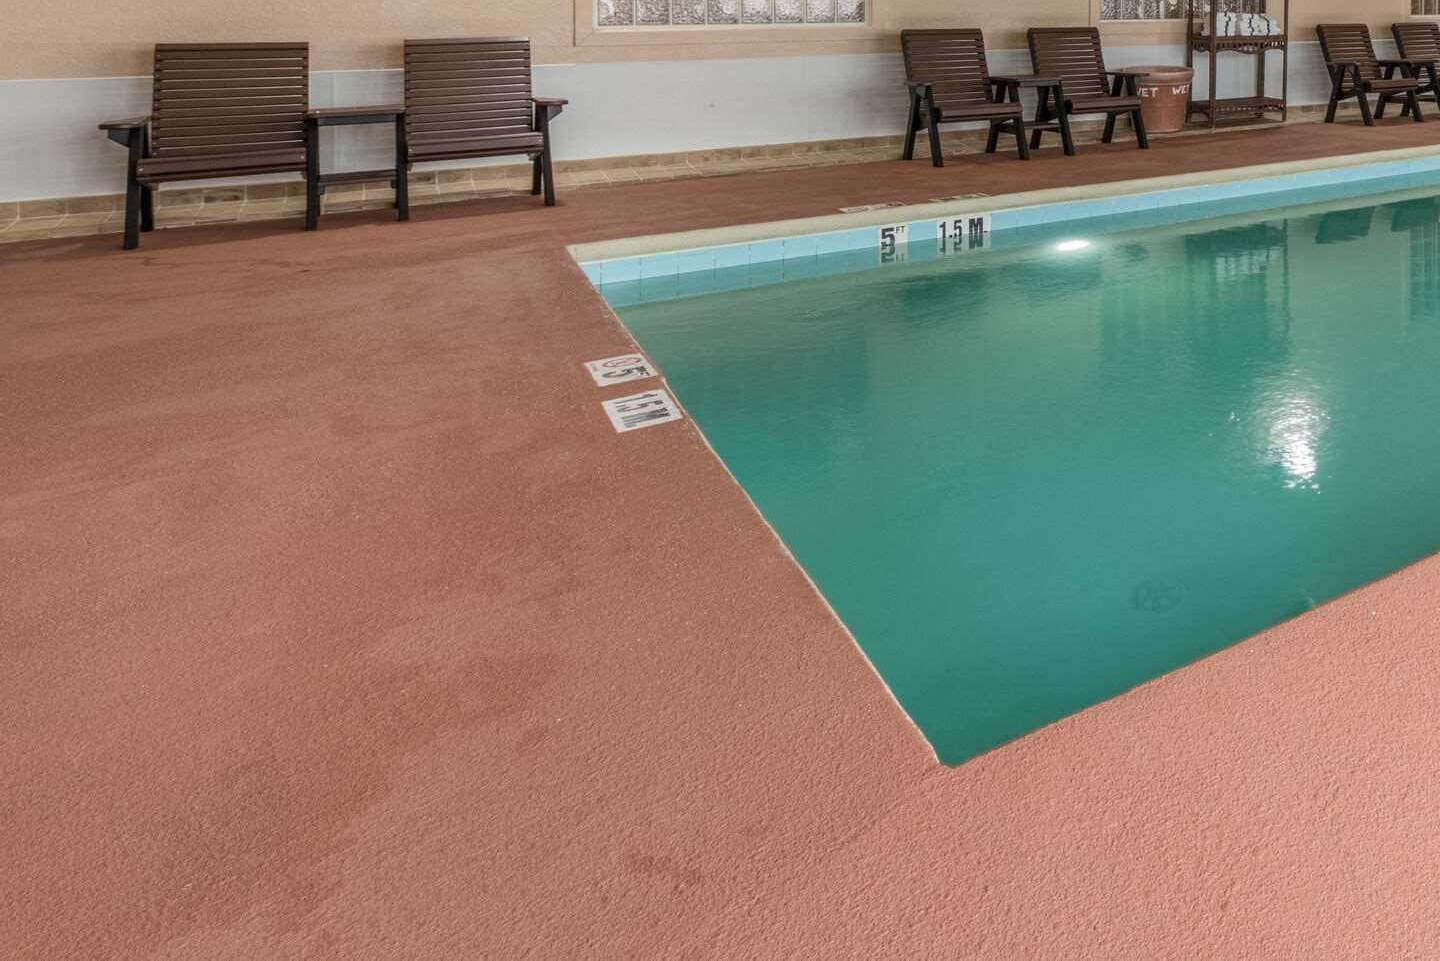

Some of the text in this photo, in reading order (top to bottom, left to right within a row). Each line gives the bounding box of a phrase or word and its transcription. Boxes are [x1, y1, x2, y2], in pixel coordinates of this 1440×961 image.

[881, 225, 905, 246] 5 FT
[939, 219, 962, 239] 1.5
